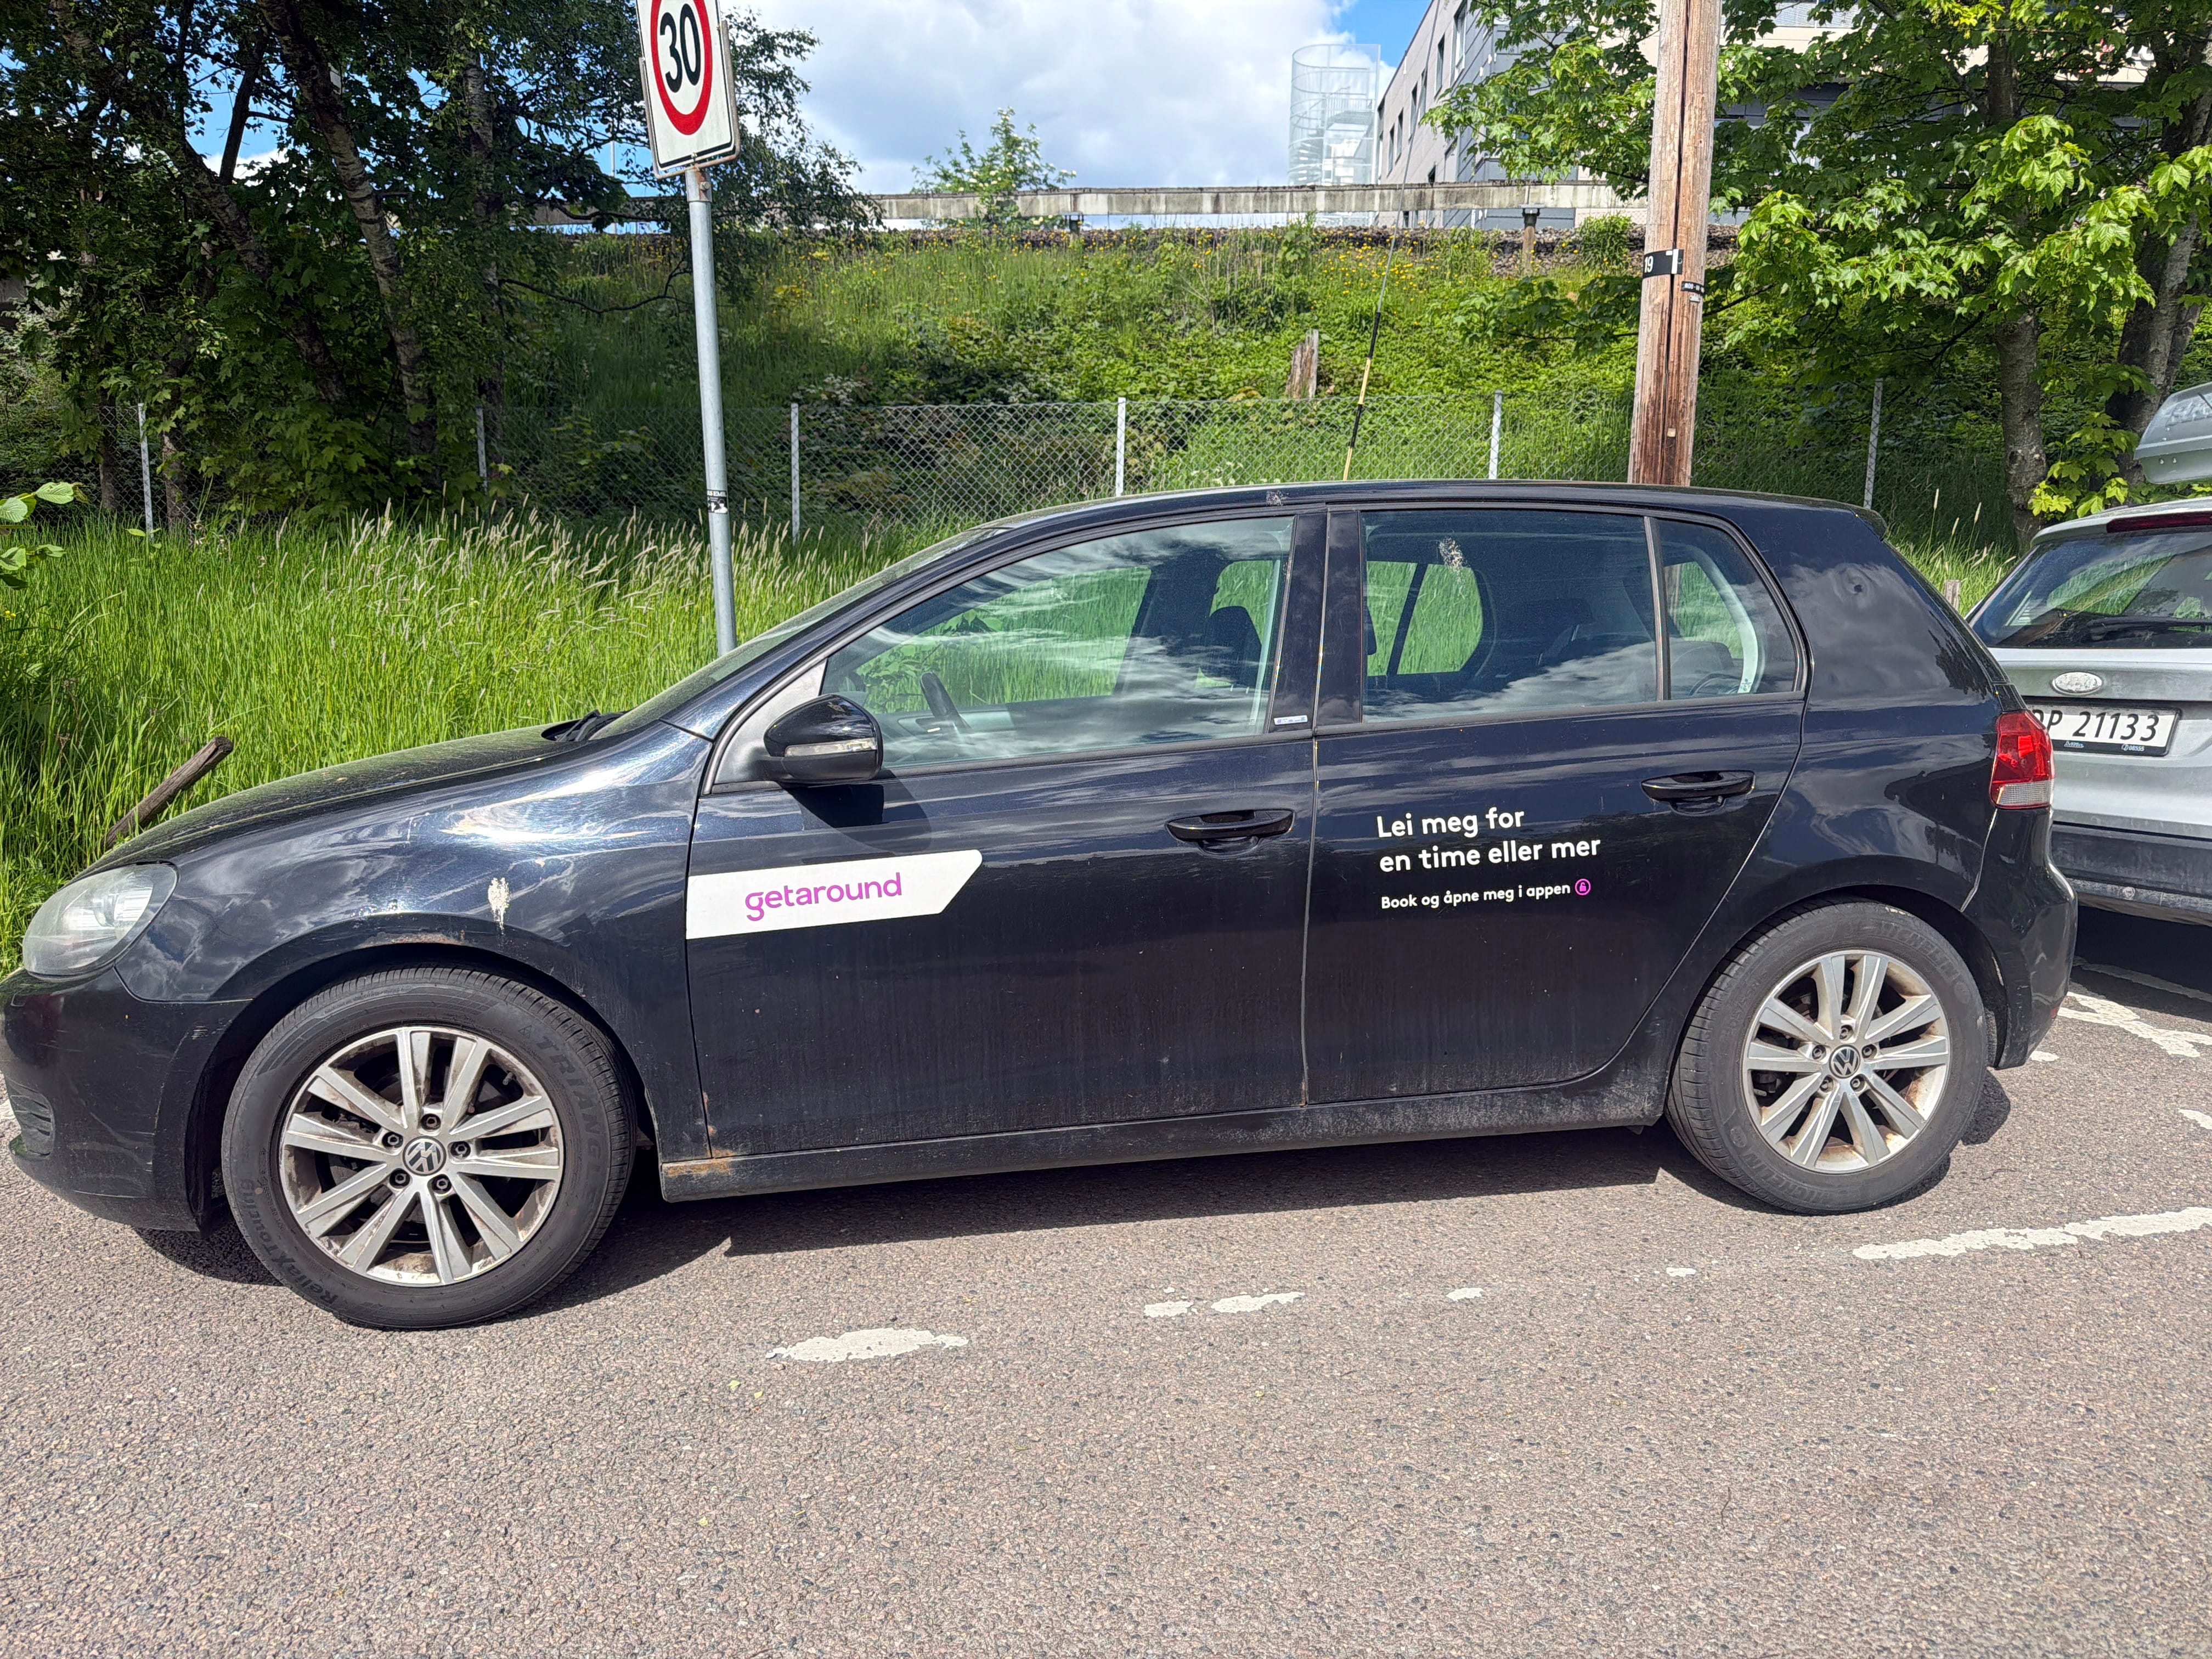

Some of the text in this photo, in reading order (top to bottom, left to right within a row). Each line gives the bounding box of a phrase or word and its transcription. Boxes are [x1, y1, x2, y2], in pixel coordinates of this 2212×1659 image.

[660, 3, 701, 93] 30
[2072, 711, 2159, 742] 21133
[1376, 807, 1525, 838] Lei meg for
[1380, 839, 1601, 872] en time eller mer
[746, 872, 902, 922] getaround
[1381, 884, 1571, 909] Book og åpne meg i appen
